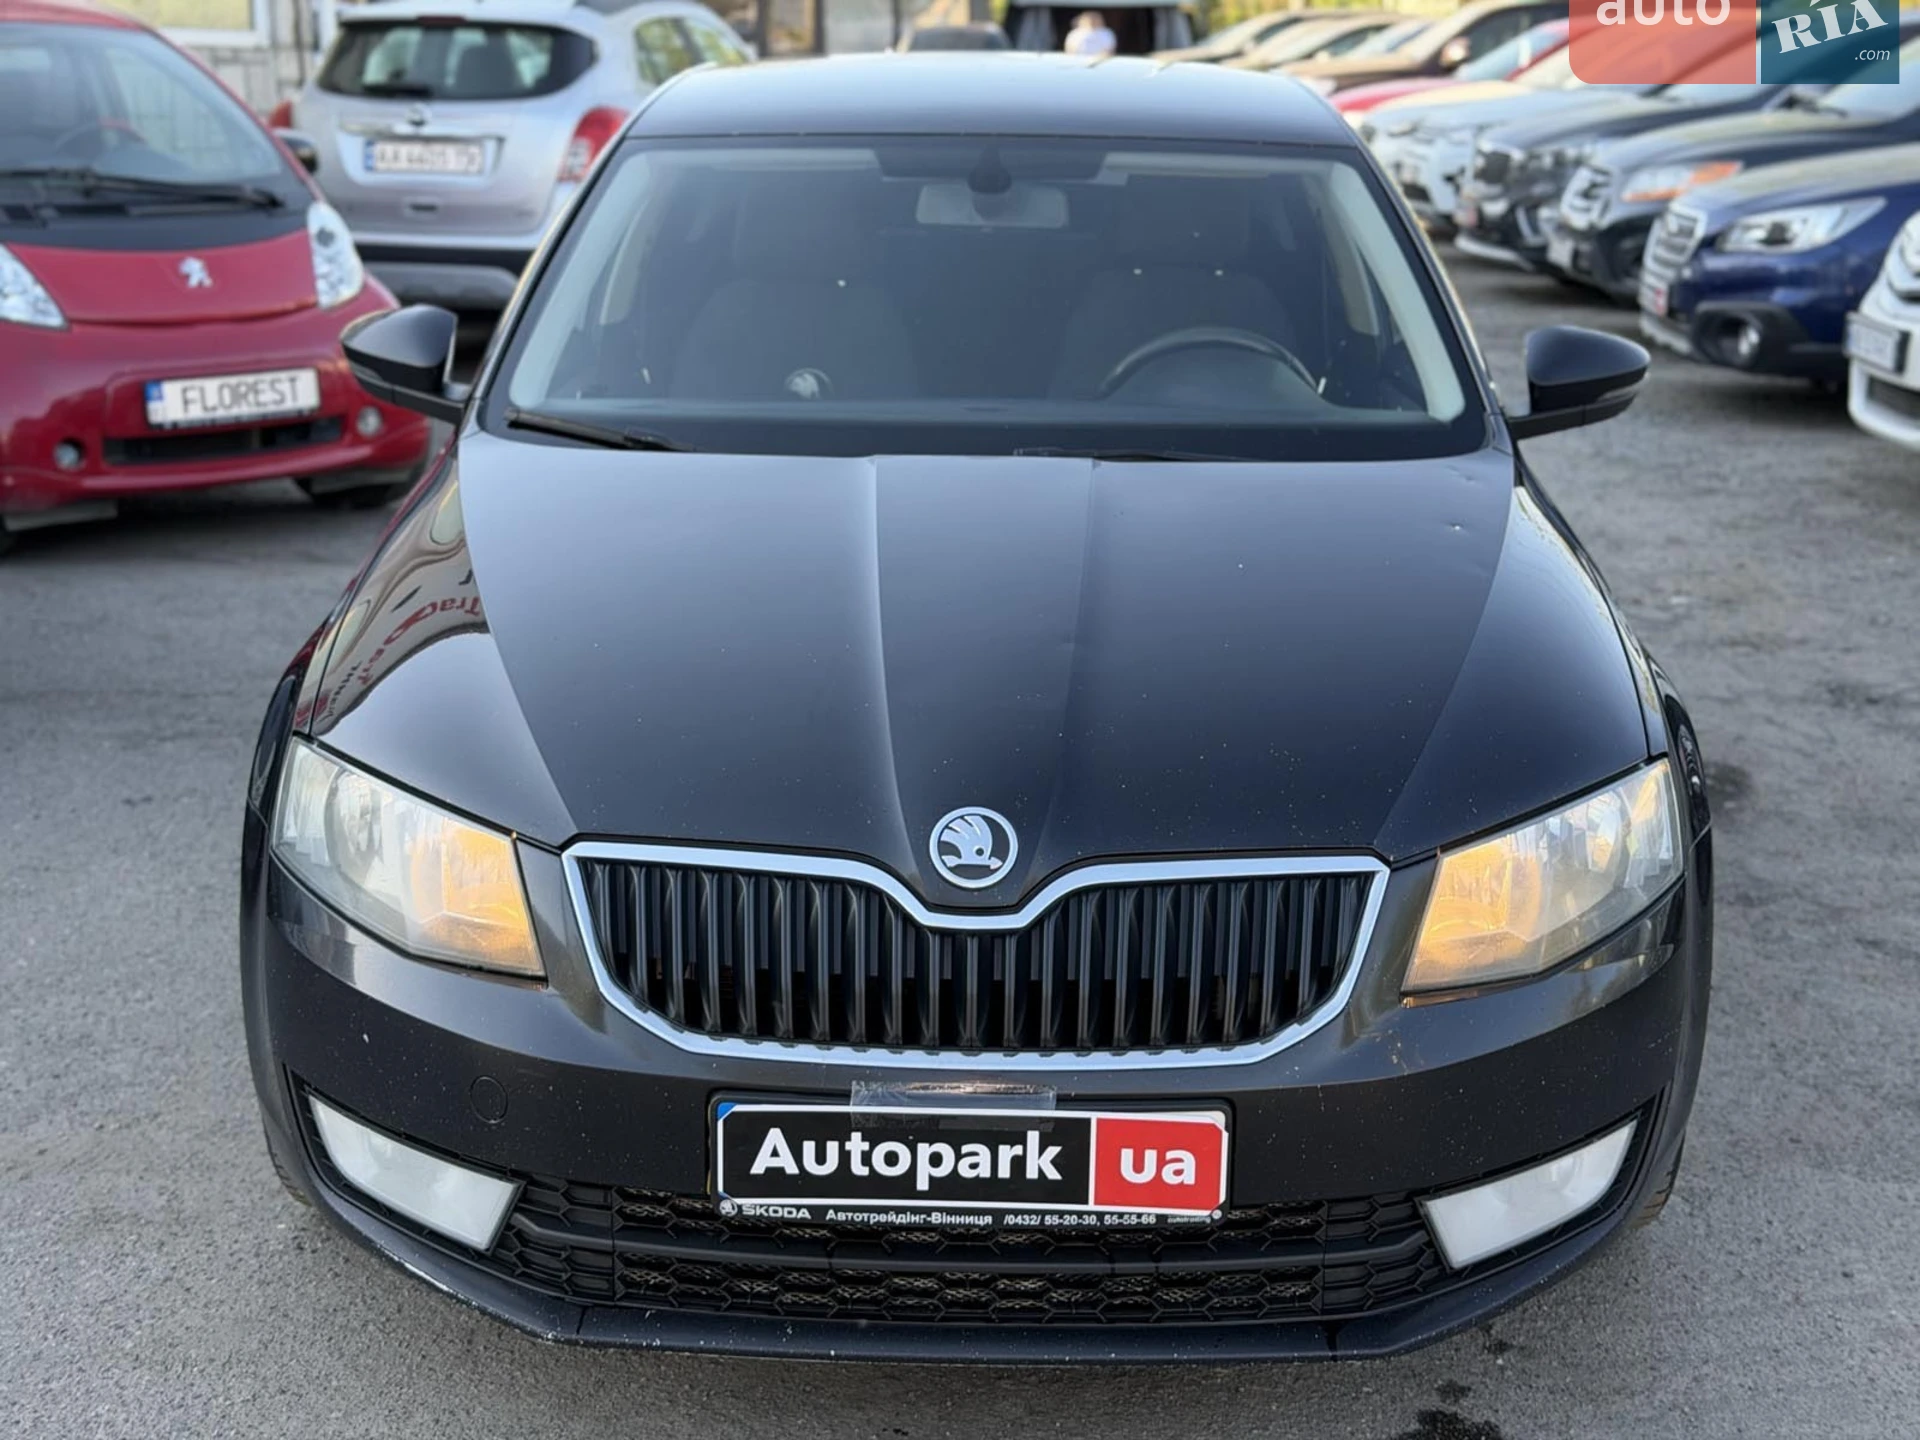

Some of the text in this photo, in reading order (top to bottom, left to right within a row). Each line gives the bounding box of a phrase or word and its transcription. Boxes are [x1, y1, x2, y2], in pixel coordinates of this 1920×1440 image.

[181, 377, 299, 414] FLOREST
[750, 1127, 1197, 1192] Autopark ua
[1044, 1213, 1100, 1227] 55-20-30,
[1103, 1213, 1157, 1226] 55-55-66
